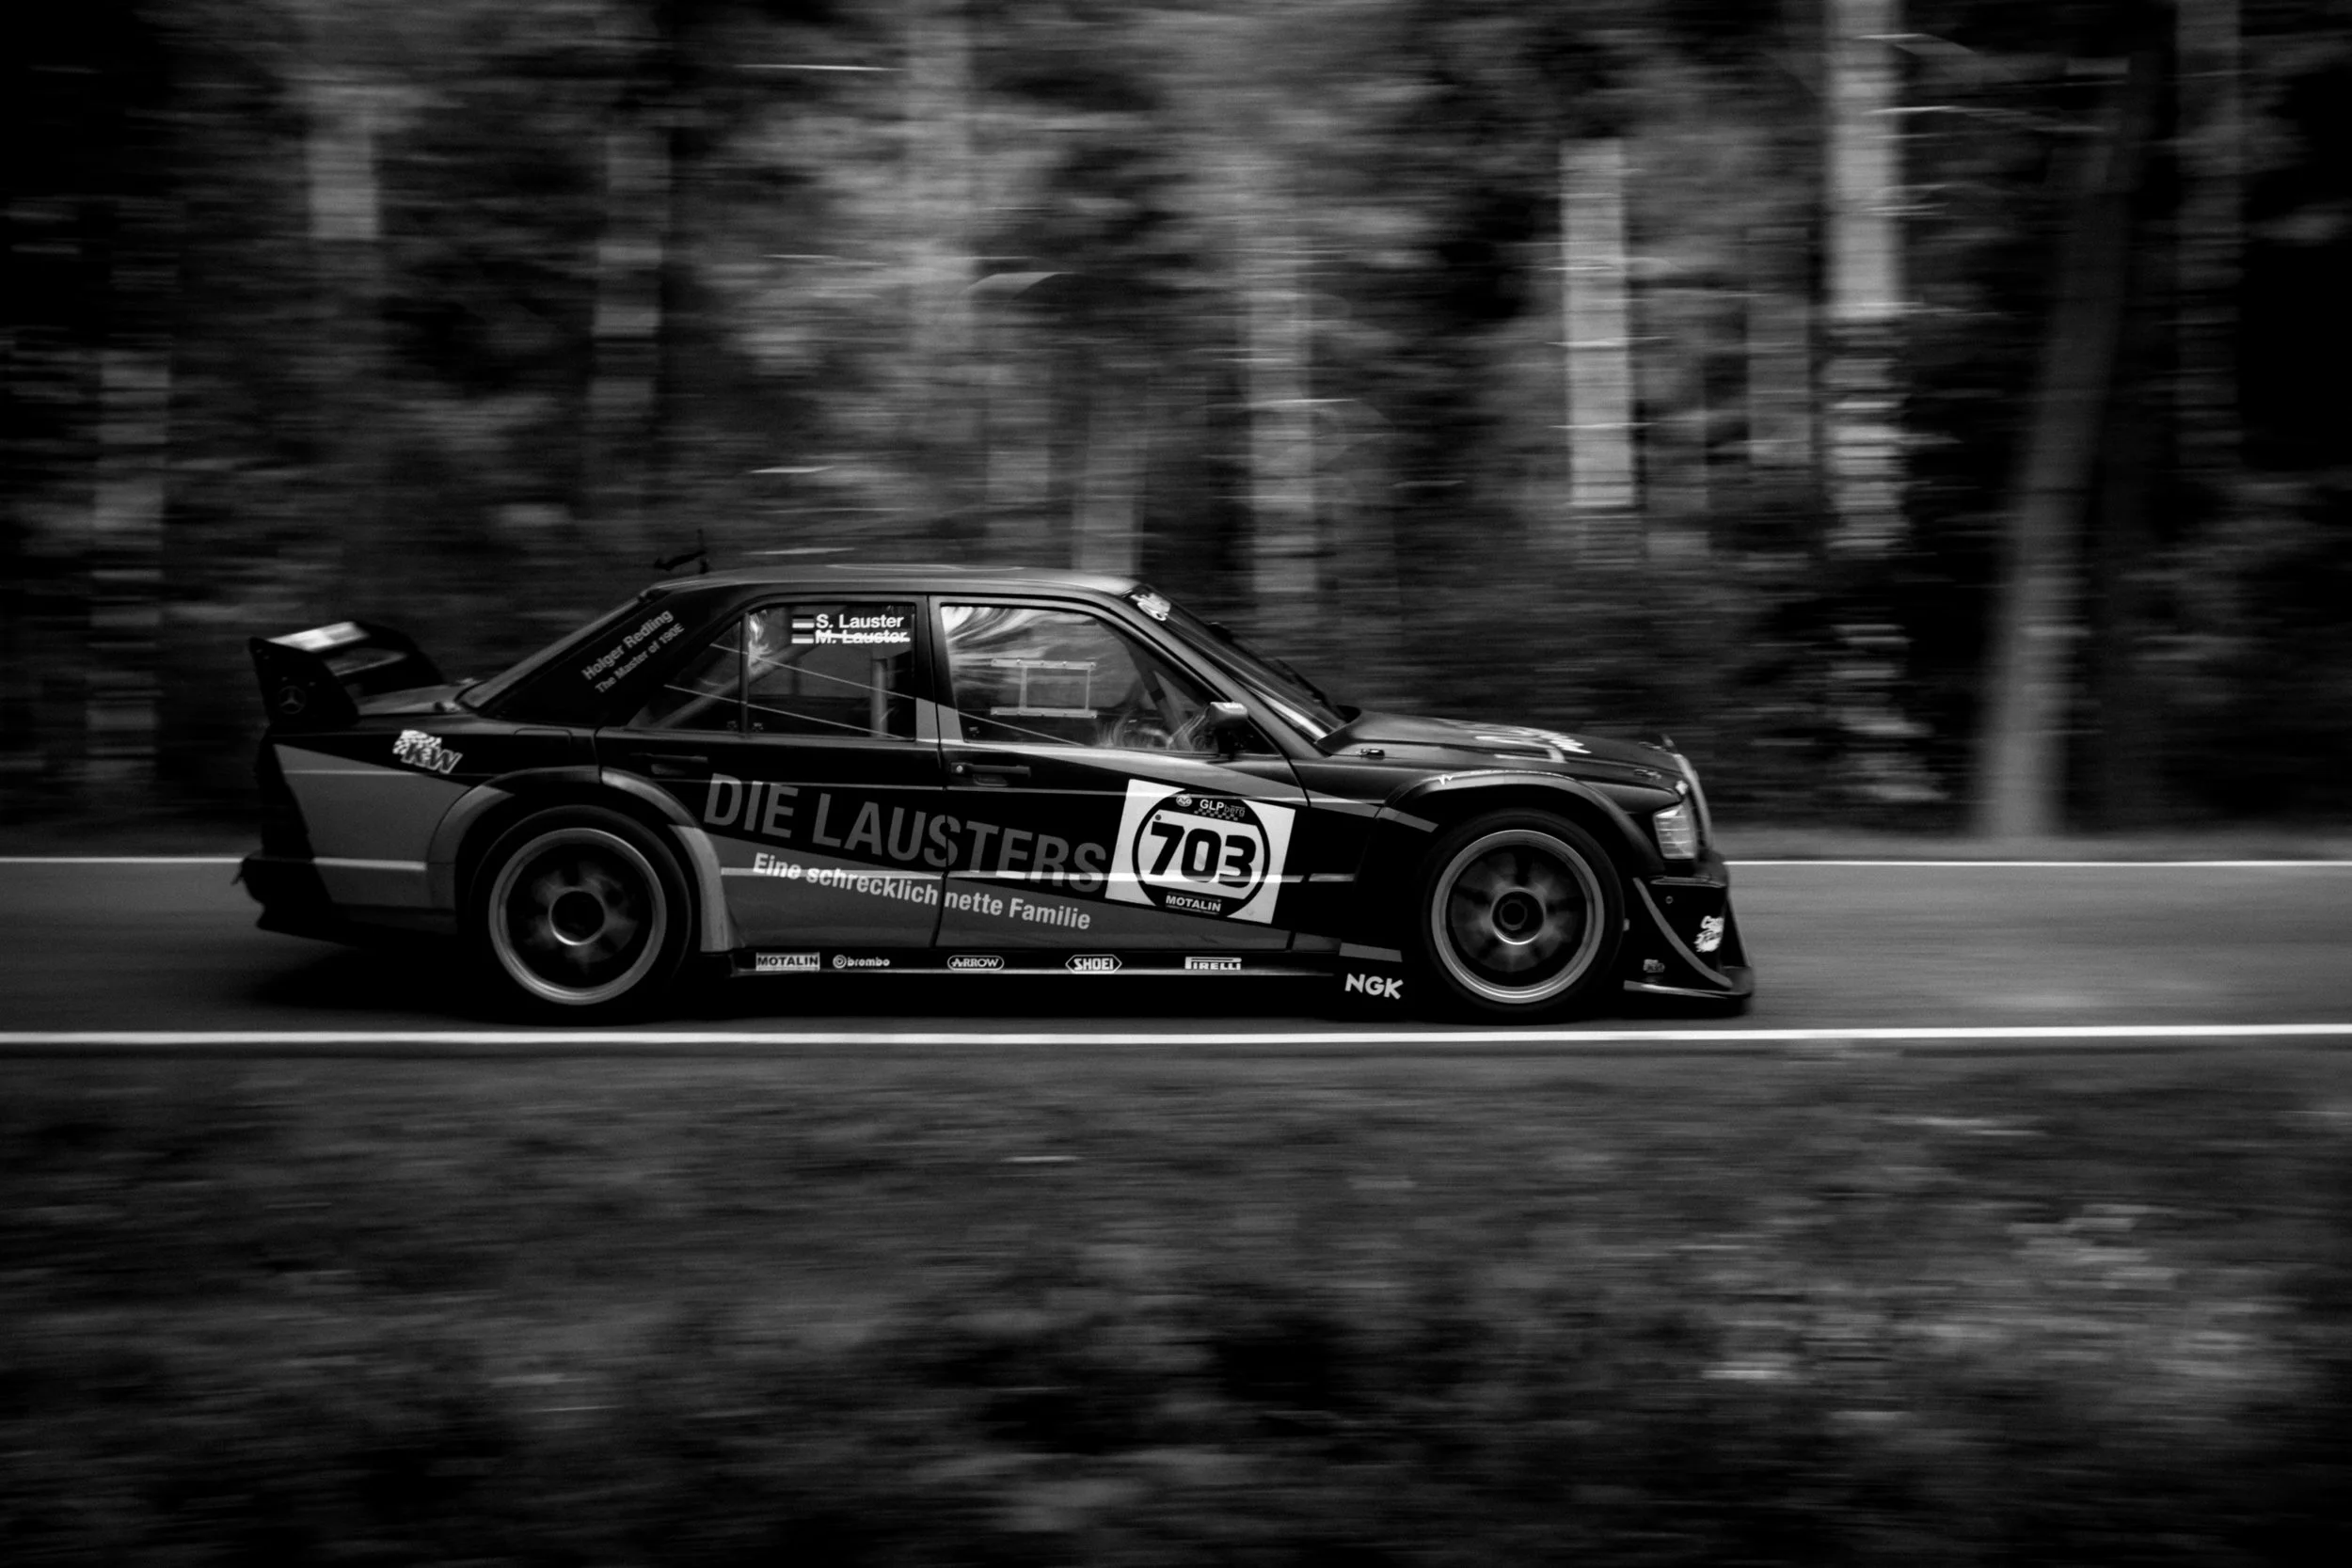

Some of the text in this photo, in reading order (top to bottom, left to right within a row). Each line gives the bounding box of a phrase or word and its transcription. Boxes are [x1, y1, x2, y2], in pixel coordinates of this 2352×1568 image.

[816, 613, 904, 628] S. Lauster
[580, 610, 674, 680] Holger Redling
[595, 676, 617, 693] The
[647, 640, 660, 654] of
[659, 623, 685, 643] 190E
[400, 739, 464, 774] KW
[704, 772, 1106, 893] DIE LAUSTERS
[1150, 821, 1256, 888] 703
[753, 852, 1090, 929] Eine schrecklich nette Familie
[1166, 895, 1222, 912] MOTALIN
[757, 956, 818, 966] MOTALIN
[1073, 957, 1114, 970] SHOEI
[1184, 956, 1242, 970] PIRELLI
[1344, 972, 1404, 1000] NGK
